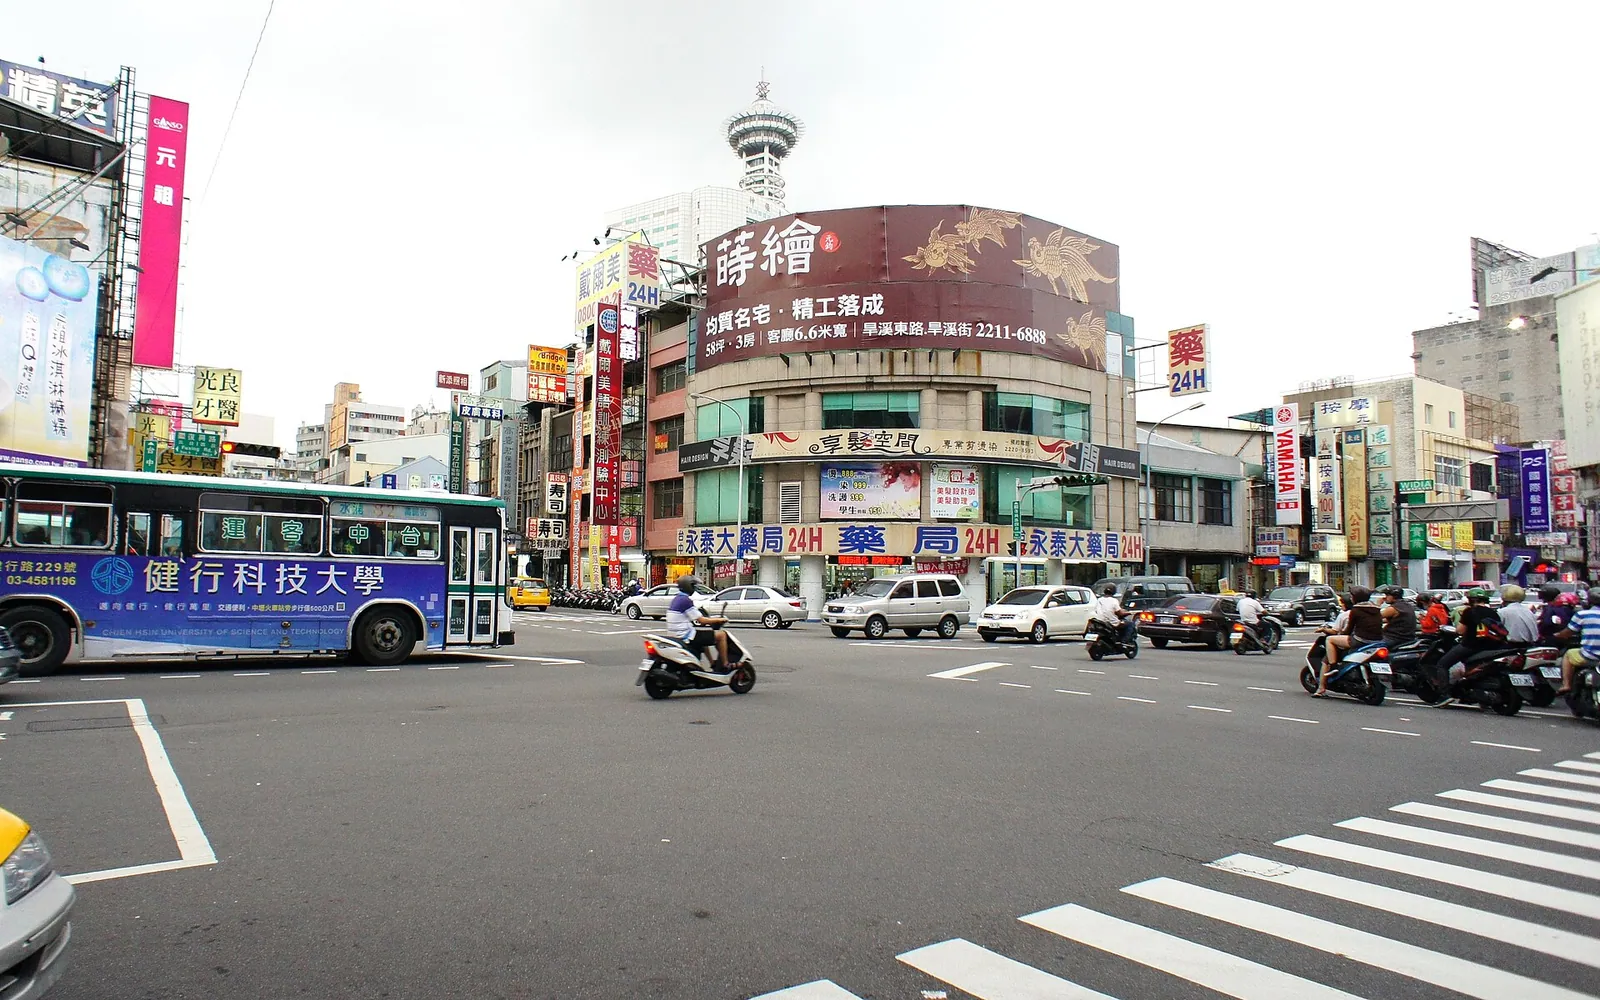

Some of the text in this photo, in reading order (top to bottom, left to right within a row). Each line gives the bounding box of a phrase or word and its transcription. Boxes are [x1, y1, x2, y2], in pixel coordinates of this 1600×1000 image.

[8, 67, 107, 126] 精英
[154, 146, 177, 207] 元祖
[628, 245, 659, 281] 藥
[716, 219, 822, 286] 蒔繪
[628, 281, 658, 305] 24H
[706, 293, 884, 336] 均質名宅 精工落成
[976, 323, 1047, 345] 2211-6888
[541, 352, 563, 363] Bridge
[1170, 329, 1204, 368] 藥
[197, 372, 239, 394] 光良
[1170, 368, 1205, 392] 24H
[195, 397, 238, 420] 牙醫
[691, 453, 708, 462] DESIGN
[1104, 459, 1136, 470] HAIR DESIGN
[1277, 429, 1295, 493] YAMAHA
[1522, 457, 1544, 467] PS
[221, 516, 421, 546] 運 客 中 台
[685, 526, 783, 554] 永泰大藥局
[787, 527, 823, 552] 24H
[837, 526, 958, 556] 藥局
[965, 528, 999, 554] 24H
[1029, 528, 1119, 559] 永泰大藥局
[1121, 534, 1142, 558] 24H
[7, 575, 76, 585] 03-4581196
[143, 559, 384, 596] 健行科技大學
[290, 628, 345, 636] TECHNOLOGY
